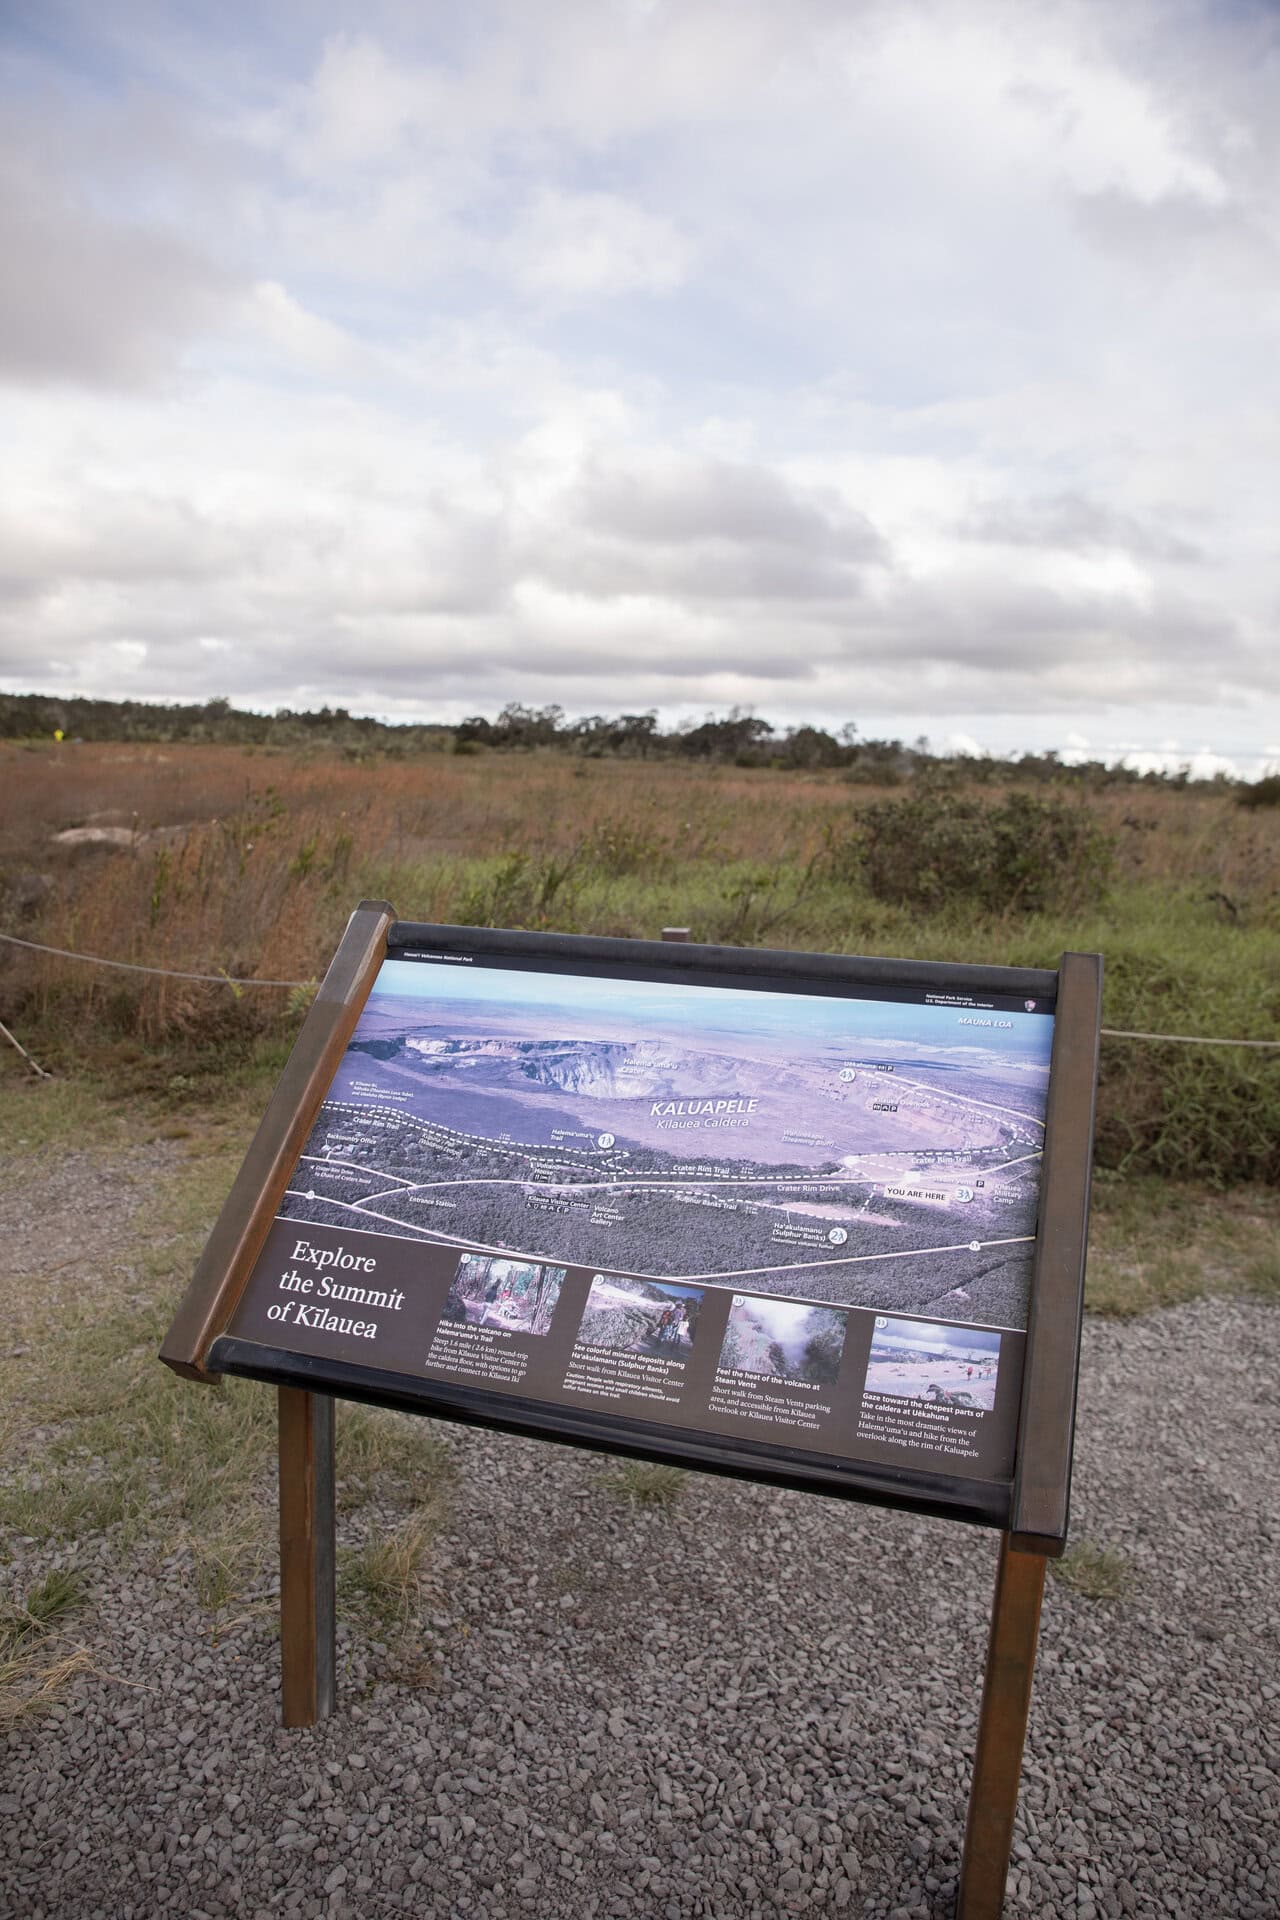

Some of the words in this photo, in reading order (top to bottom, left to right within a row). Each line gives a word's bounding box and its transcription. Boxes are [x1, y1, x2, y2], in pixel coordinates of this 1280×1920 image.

[958, 1018, 992, 1026] MAUNA
[651, 1100, 759, 1116] KALUAPELE
[704, 1118, 748, 1128] Caldera
[887, 1187, 905, 1196] YOU
[908, 1189, 924, 1198] ARE
[925, 1192, 946, 1200] HERE
[436, 1199, 456, 1208] Station
[290, 1241, 376, 1273] Explore
[279, 1270, 313, 1293] the
[317, 1276, 405, 1310] Summit
[267, 1302, 295, 1321] of
[293, 1303, 378, 1339] Kīlauea
[586, 1347, 611, 1355] colorful
[612, 1352, 636, 1360] mineral
[638, 1355, 664, 1365] deposits
[666, 1360, 685, 1369] along
[568, 1361, 585, 1370] Short
[601, 1367, 616, 1375] from
[642, 1374, 661, 1383] Visitor
[663, 1378, 684, 1387] Center
[618, 1360, 645, 1370] (Sulphur
[647, 1365, 668, 1375] Banks)
[715, 1376, 736, 1384] Steam
[738, 1380, 756, 1388] Vents
[745, 1372, 760, 1380] heat
[784, 1380, 810, 1389] volcano
[712, 1386, 730, 1394] Short
[748, 1392, 763, 1400] from
[764, 1395, 784, 1404] Steam
[786, 1398, 804, 1407] Vents
[805, 1403, 830, 1413] parking
[740, 1402, 772, 1411] accessible
[773, 1406, 789, 1414] from
[863, 1393, 880, 1401] Gaze
[882, 1396, 908, 1406] toward
[924, 1403, 953, 1413] deepest
[708, 1404, 738, 1415] Overlook
[775, 1415, 796, 1424] Visitor
[797, 1418, 820, 1429] Center
[875, 1404, 901, 1413] caldera
[860, 1411, 875, 1420] Take
[916, 1421, 946, 1432] dramatic
[948, 1427, 966, 1435] views
[857, 1432, 886, 1441] overlook
[888, 1436, 907, 1446] along
[944, 1445, 978, 1457] Kaluapele
[924, 1432, 938, 1440] hike
[940, 1435, 956, 1444] from
[958, 1438, 970, 1446] the
